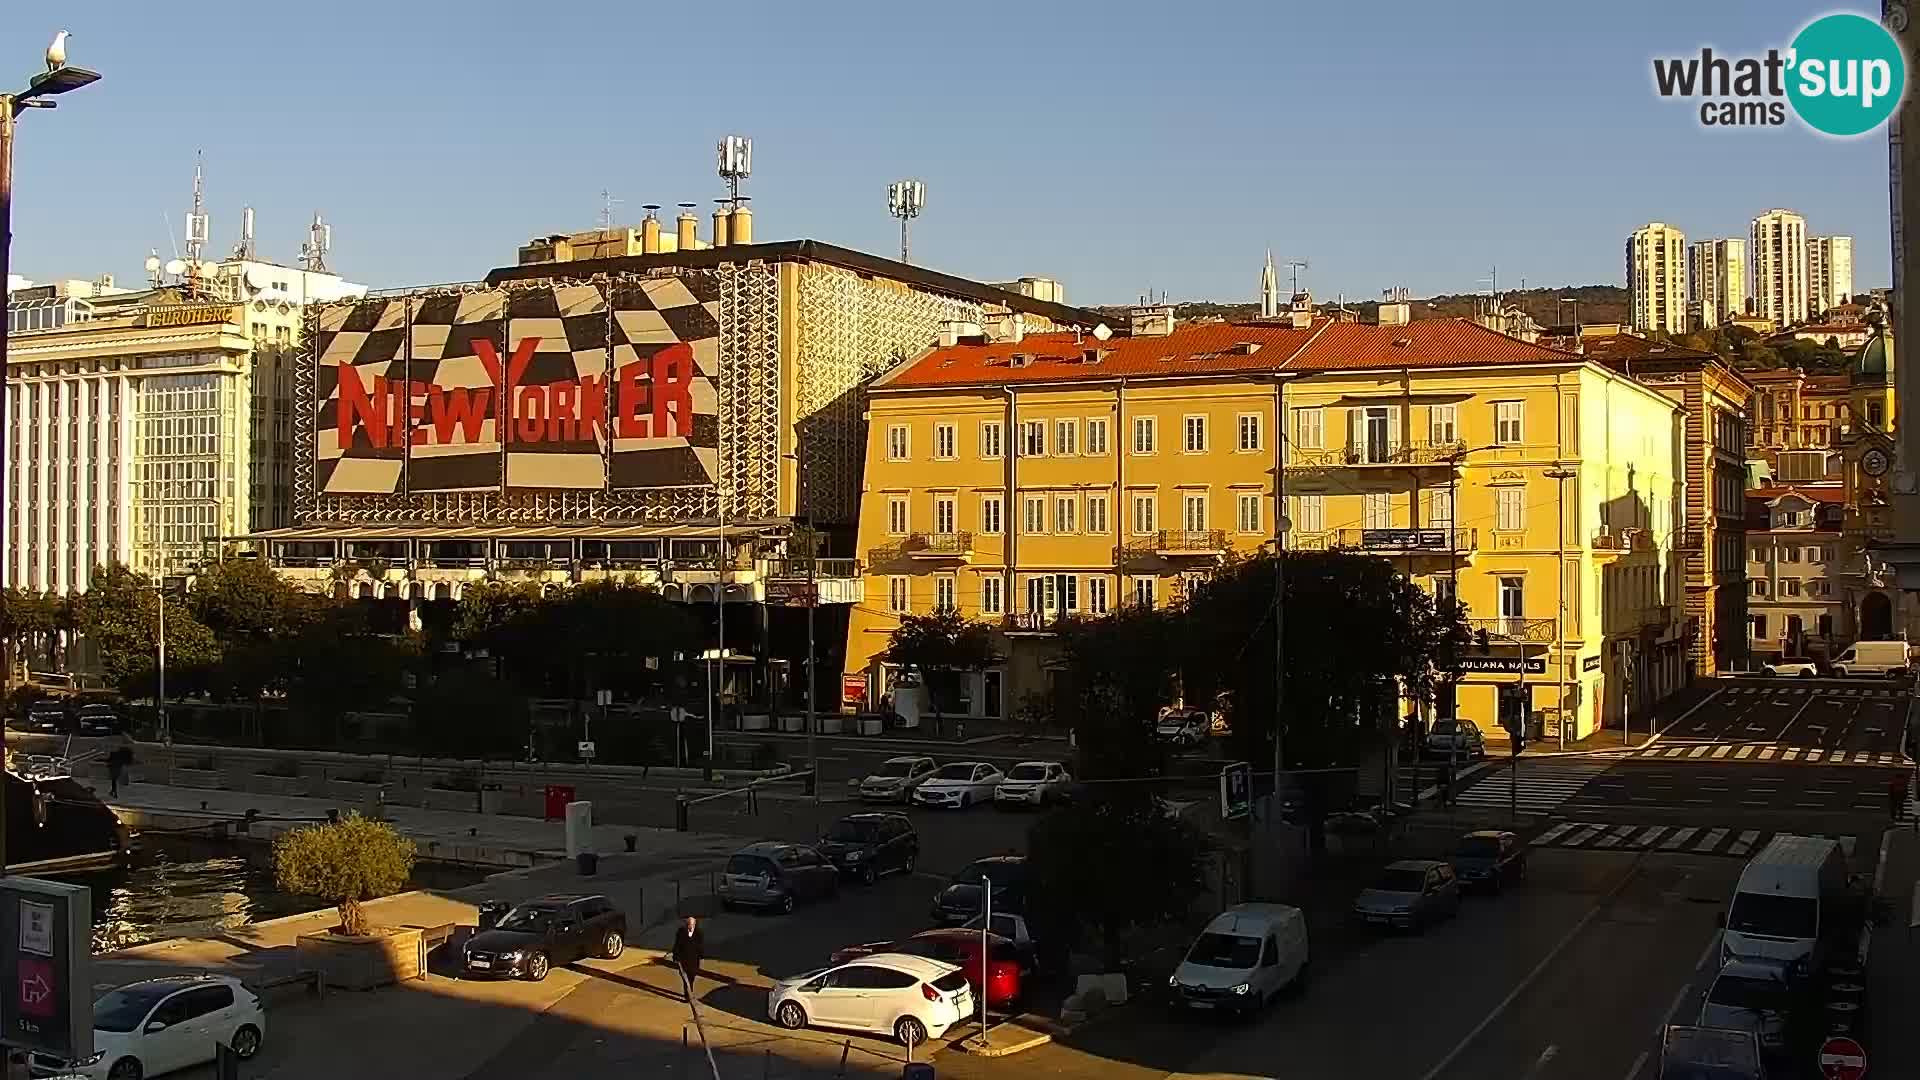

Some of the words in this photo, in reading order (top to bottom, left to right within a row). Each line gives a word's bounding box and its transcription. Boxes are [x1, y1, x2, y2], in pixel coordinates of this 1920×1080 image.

[338, 360, 494, 449] NEW
[470, 337, 693, 443] YORKER
[1459, 661, 1505, 669] JULIANA
[1508, 662, 1541, 670] NAILS
[19, 1019, 25, 1030] 5
[26, 1021, 40, 1032] km
